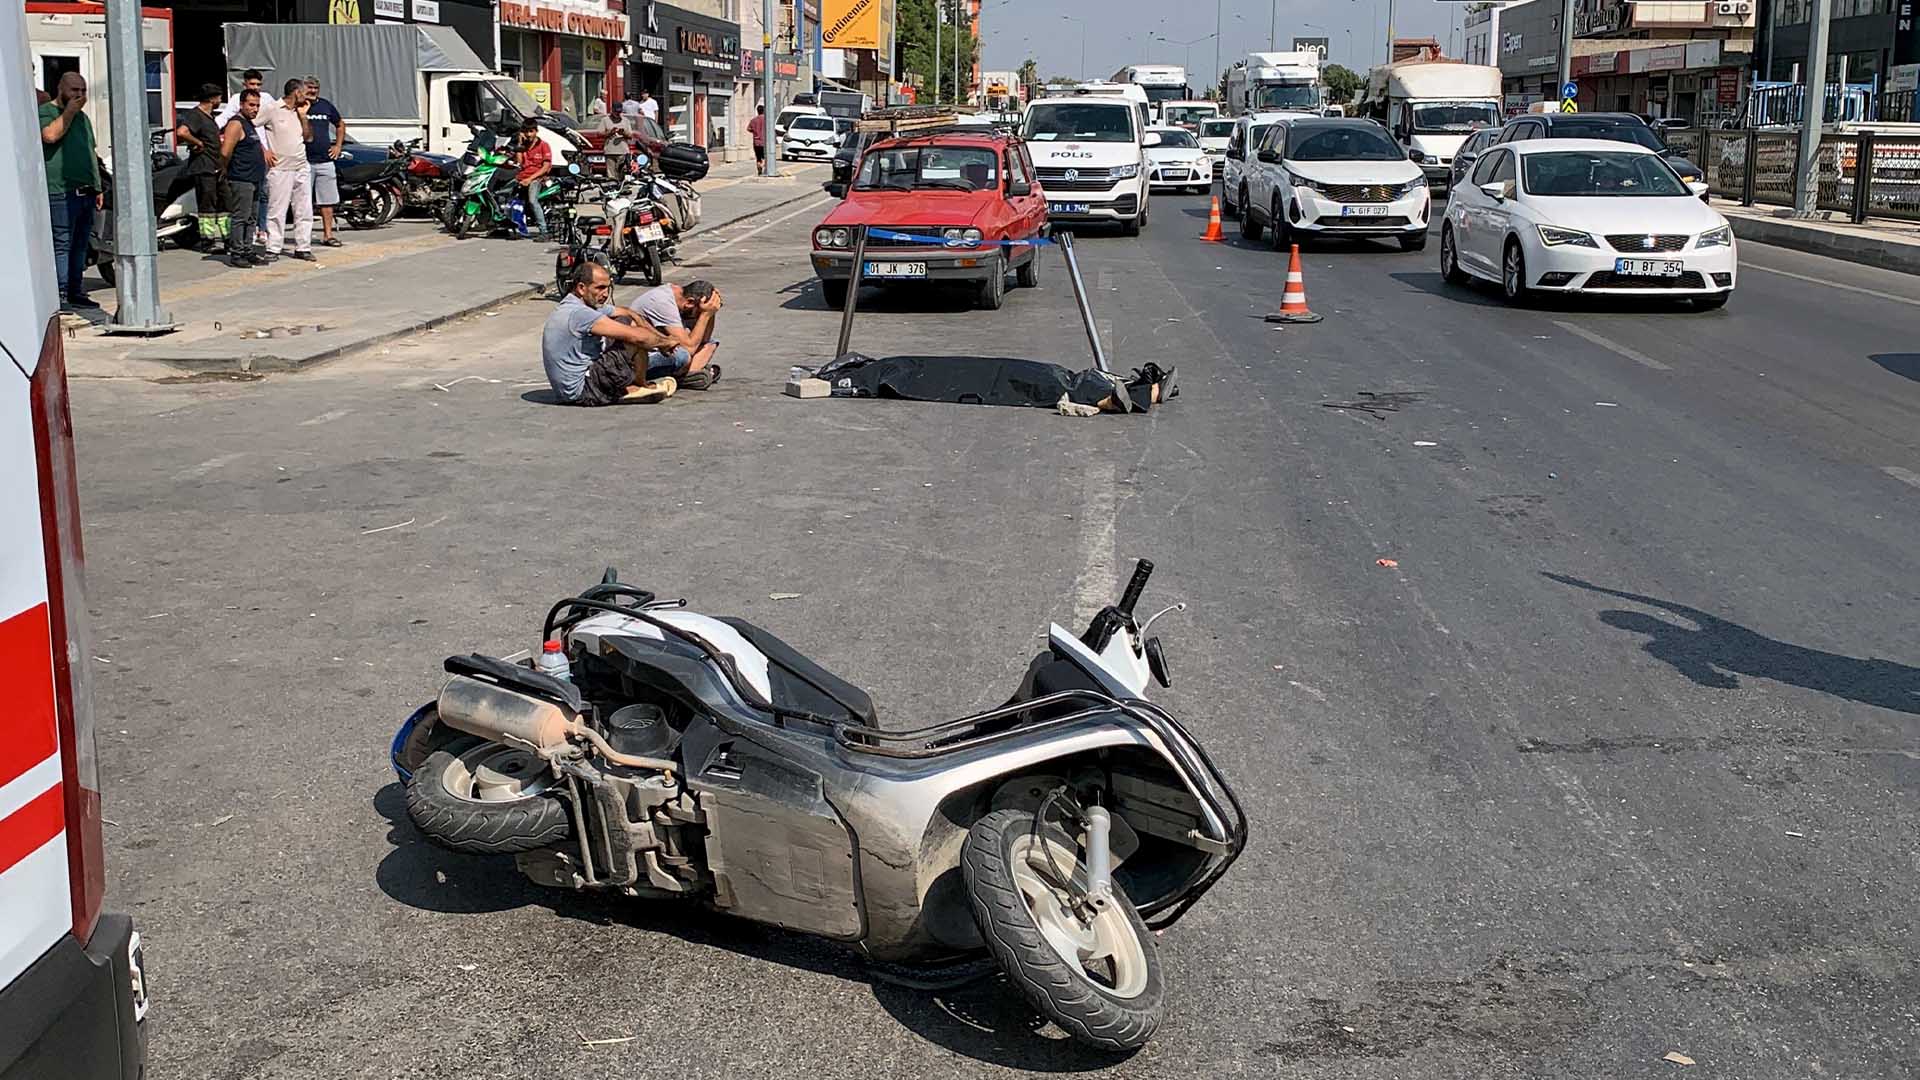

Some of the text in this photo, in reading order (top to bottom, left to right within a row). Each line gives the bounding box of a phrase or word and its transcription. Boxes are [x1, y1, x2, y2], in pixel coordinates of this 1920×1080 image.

[1297, 42, 1326, 54] bien
[870, 263, 924, 273] 01 JK 376
[1623, 260, 1680, 272] 01 BT 354
